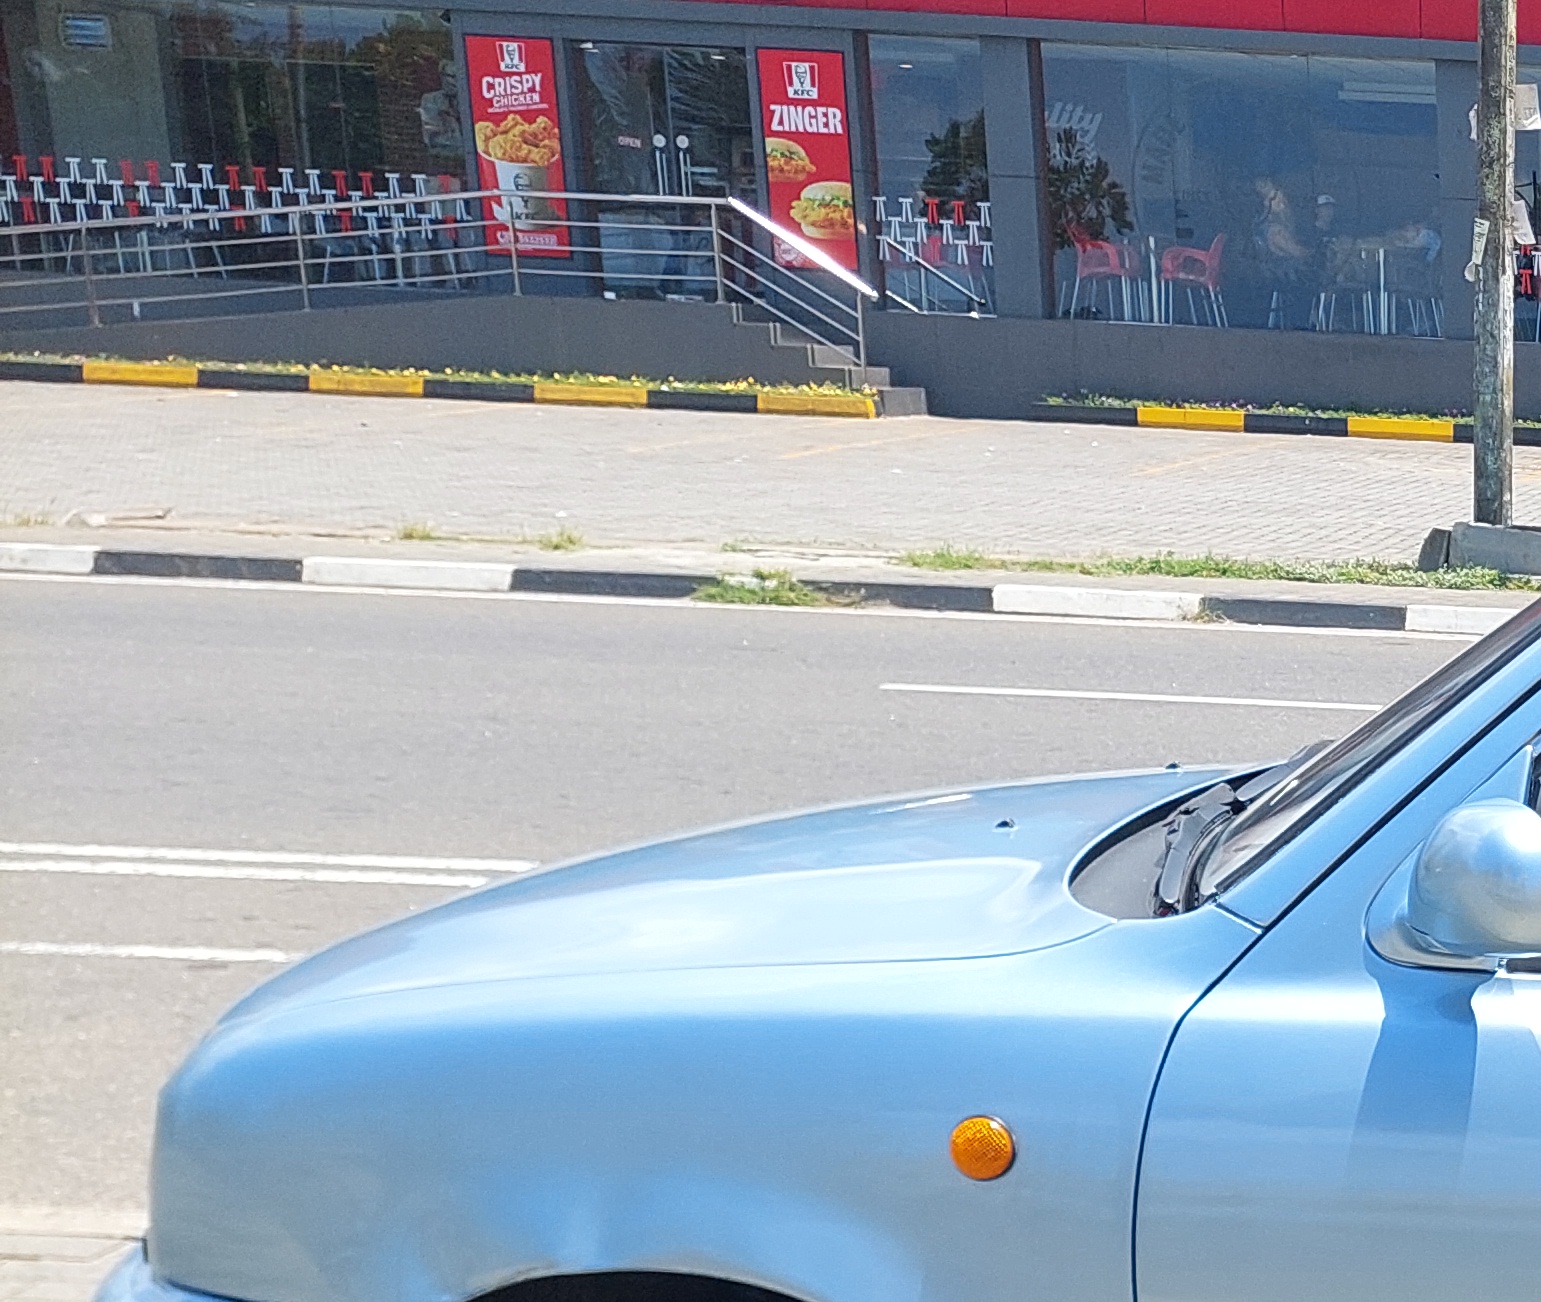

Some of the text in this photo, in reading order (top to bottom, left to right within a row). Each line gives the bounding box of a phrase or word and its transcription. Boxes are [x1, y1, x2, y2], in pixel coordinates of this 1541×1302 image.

[503, 62, 522, 71] KFC
[481, 72, 542, 99] CRISPY
[792, 88, 814, 98] KFC
[492, 92, 541, 108] CHICKEN
[769, 104, 844, 134] ZINGER
